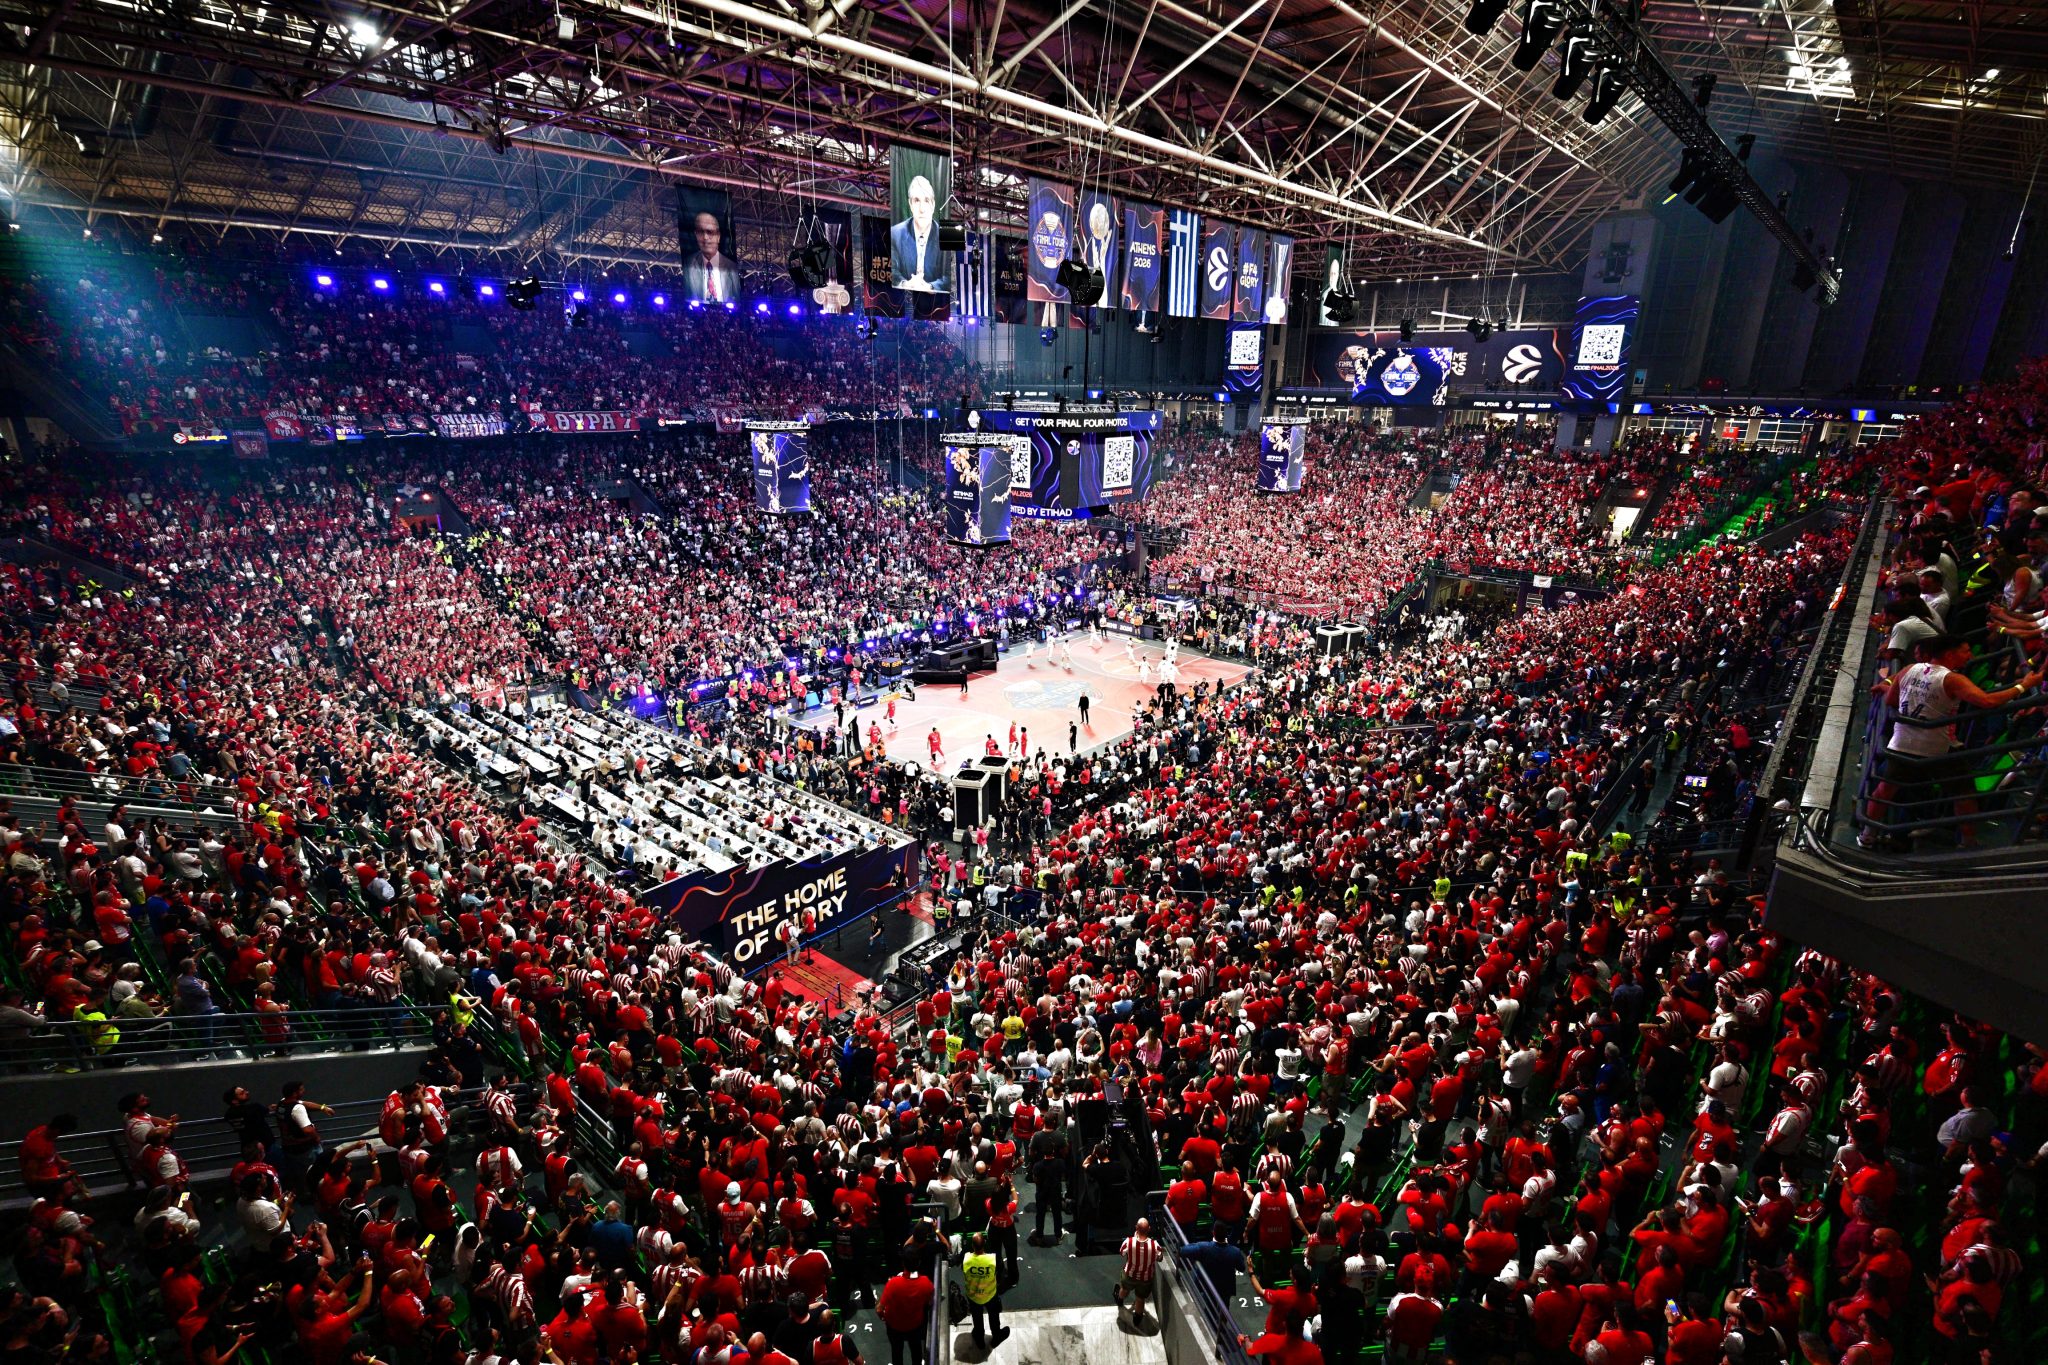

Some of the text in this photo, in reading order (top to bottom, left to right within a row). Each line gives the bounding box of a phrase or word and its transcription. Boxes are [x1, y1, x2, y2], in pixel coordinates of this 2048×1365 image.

[1036, 235, 1066, 248] FINAL FOUR
[1129, 241, 1156, 256] ATHENS
[1133, 257, 1151, 268] 2026
[1242, 262, 1258, 277] #F4
[1240, 275, 1259, 289] GLORY
[1015, 418, 1128, 428] GET YOUR FINAL FOUR PHOTOS
[1027, 507, 1038, 517] BY
[1039, 507, 1073, 517] ETIHAD
[730, 866, 847, 936] THE HOME
[733, 930, 770, 962] OF
[970, 1266, 991, 1275] CSI
